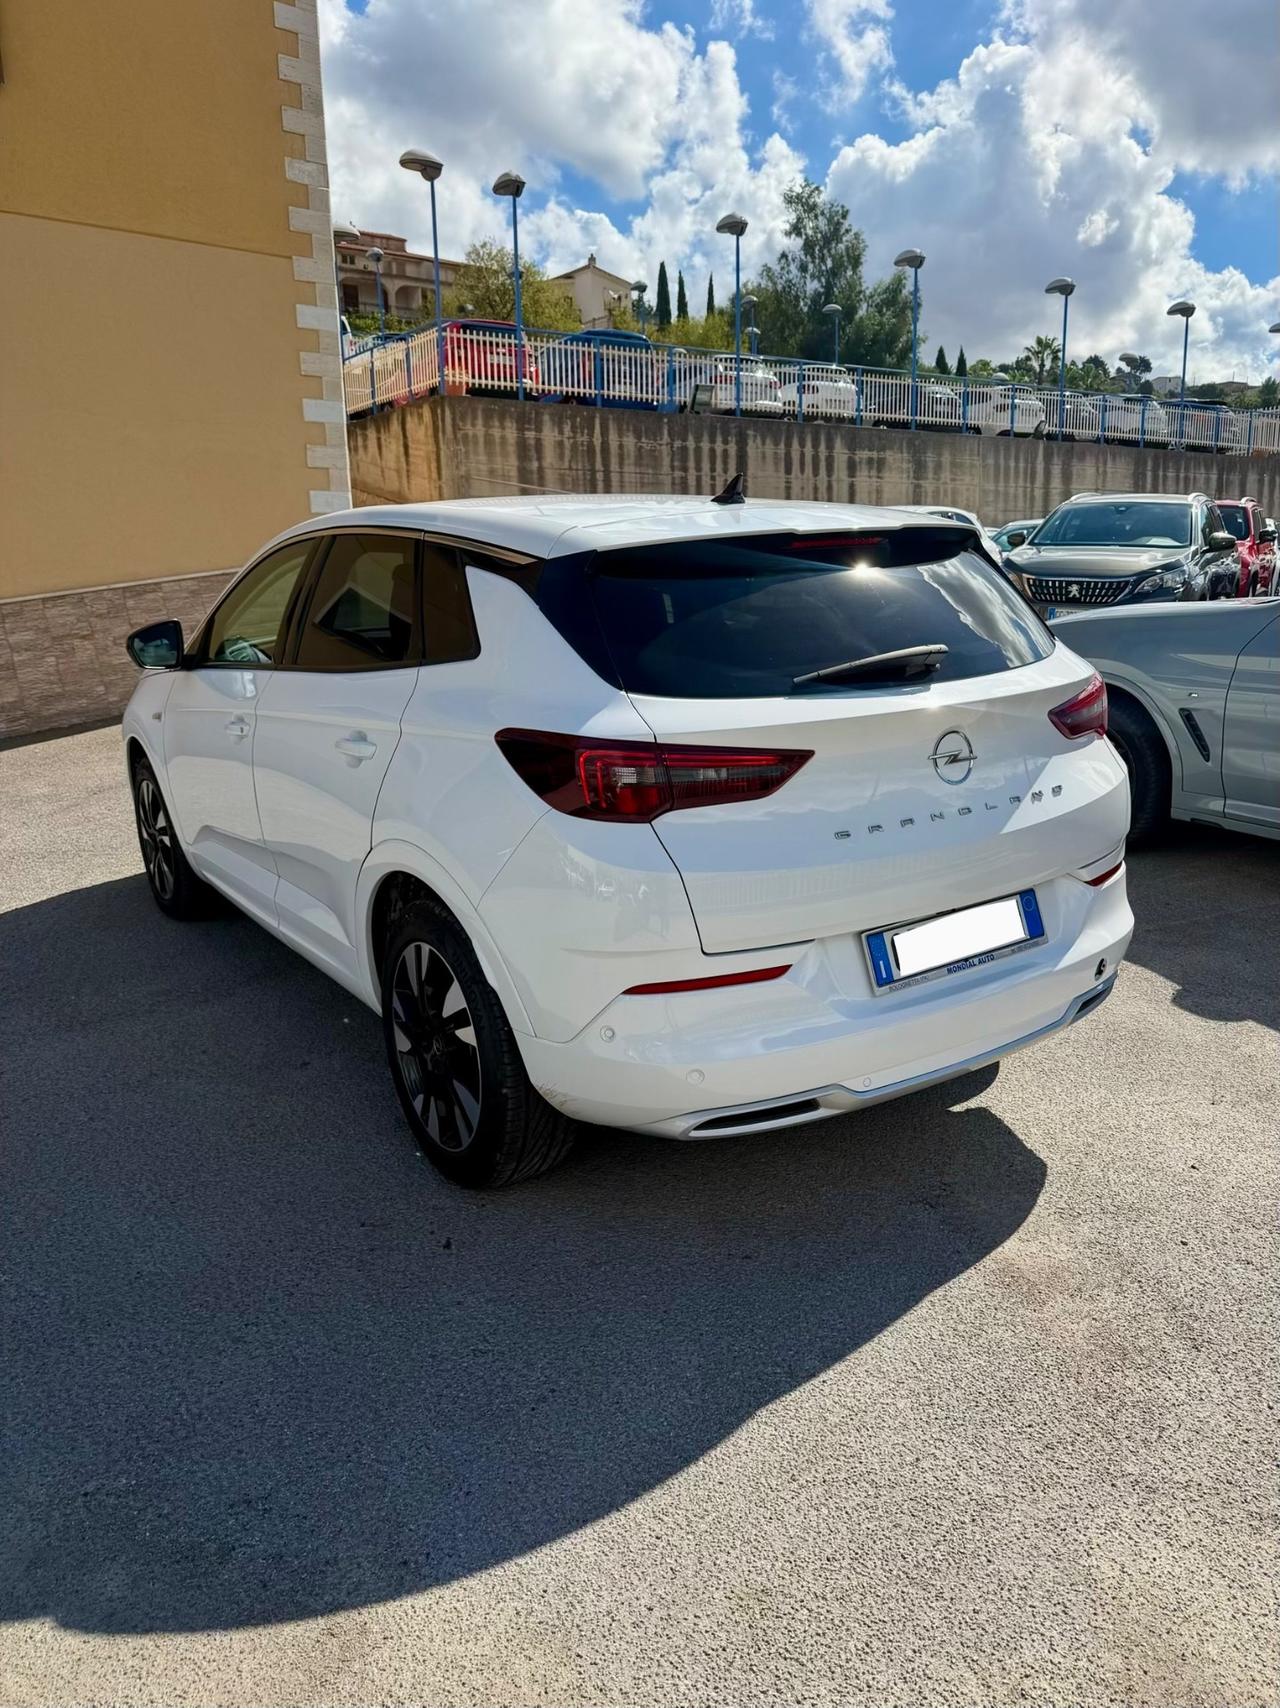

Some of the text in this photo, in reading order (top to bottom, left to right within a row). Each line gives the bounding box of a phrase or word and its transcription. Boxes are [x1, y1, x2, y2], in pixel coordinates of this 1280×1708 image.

[834, 784, 1063, 840] GRANDLAND
[946, 953, 995, 975] MONDIAL AUTO
